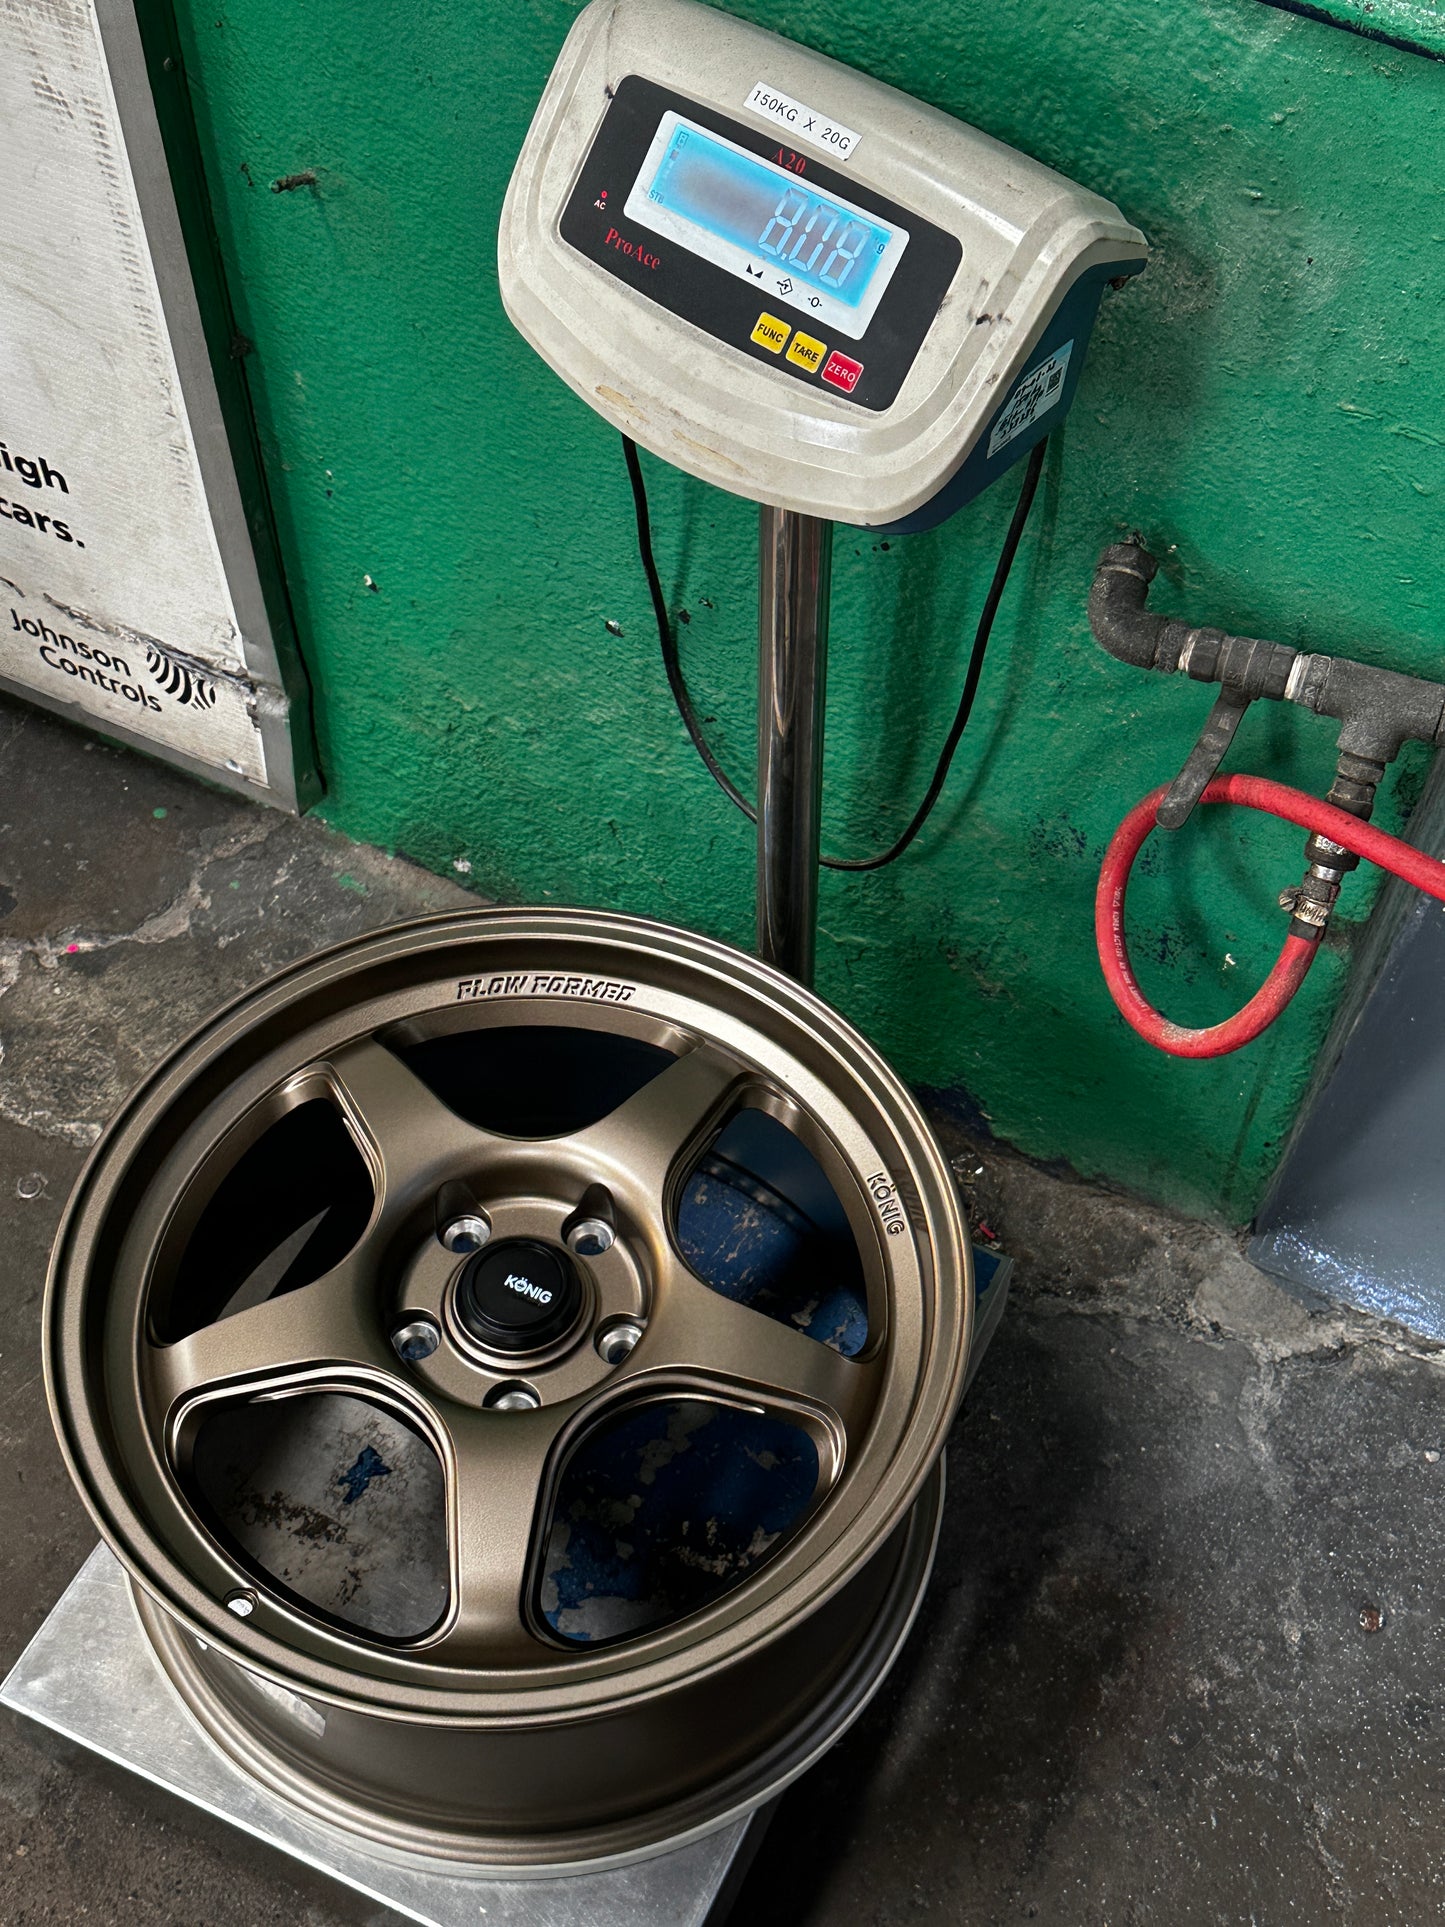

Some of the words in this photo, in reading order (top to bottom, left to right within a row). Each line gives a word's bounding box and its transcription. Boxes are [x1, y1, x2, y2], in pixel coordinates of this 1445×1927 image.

[753, 90, 798, 122] 150KG
[803, 117, 816, 132] X
[821, 127, 851, 150] 20G
[771, 147, 806, 174] A20
[594, 200, 606, 210] AC
[604, 227, 660, 269] ProAce
[758, 187, 871, 288] 8.08
[757, 323, 784, 343] FUNC
[793, 343, 819, 363] TARE
[827, 362, 856, 382] ZERO
[0, 442, 69, 494] igh
[10, 608, 131, 677] Johnson
[39, 646, 162, 713] Controls
[457, 974, 529, 999] FLOW
[531, 975, 636, 1001] FORMED
[867, 1172, 905, 1235] KÖNIG
[504, 1274, 553, 1303] KÖNIG
